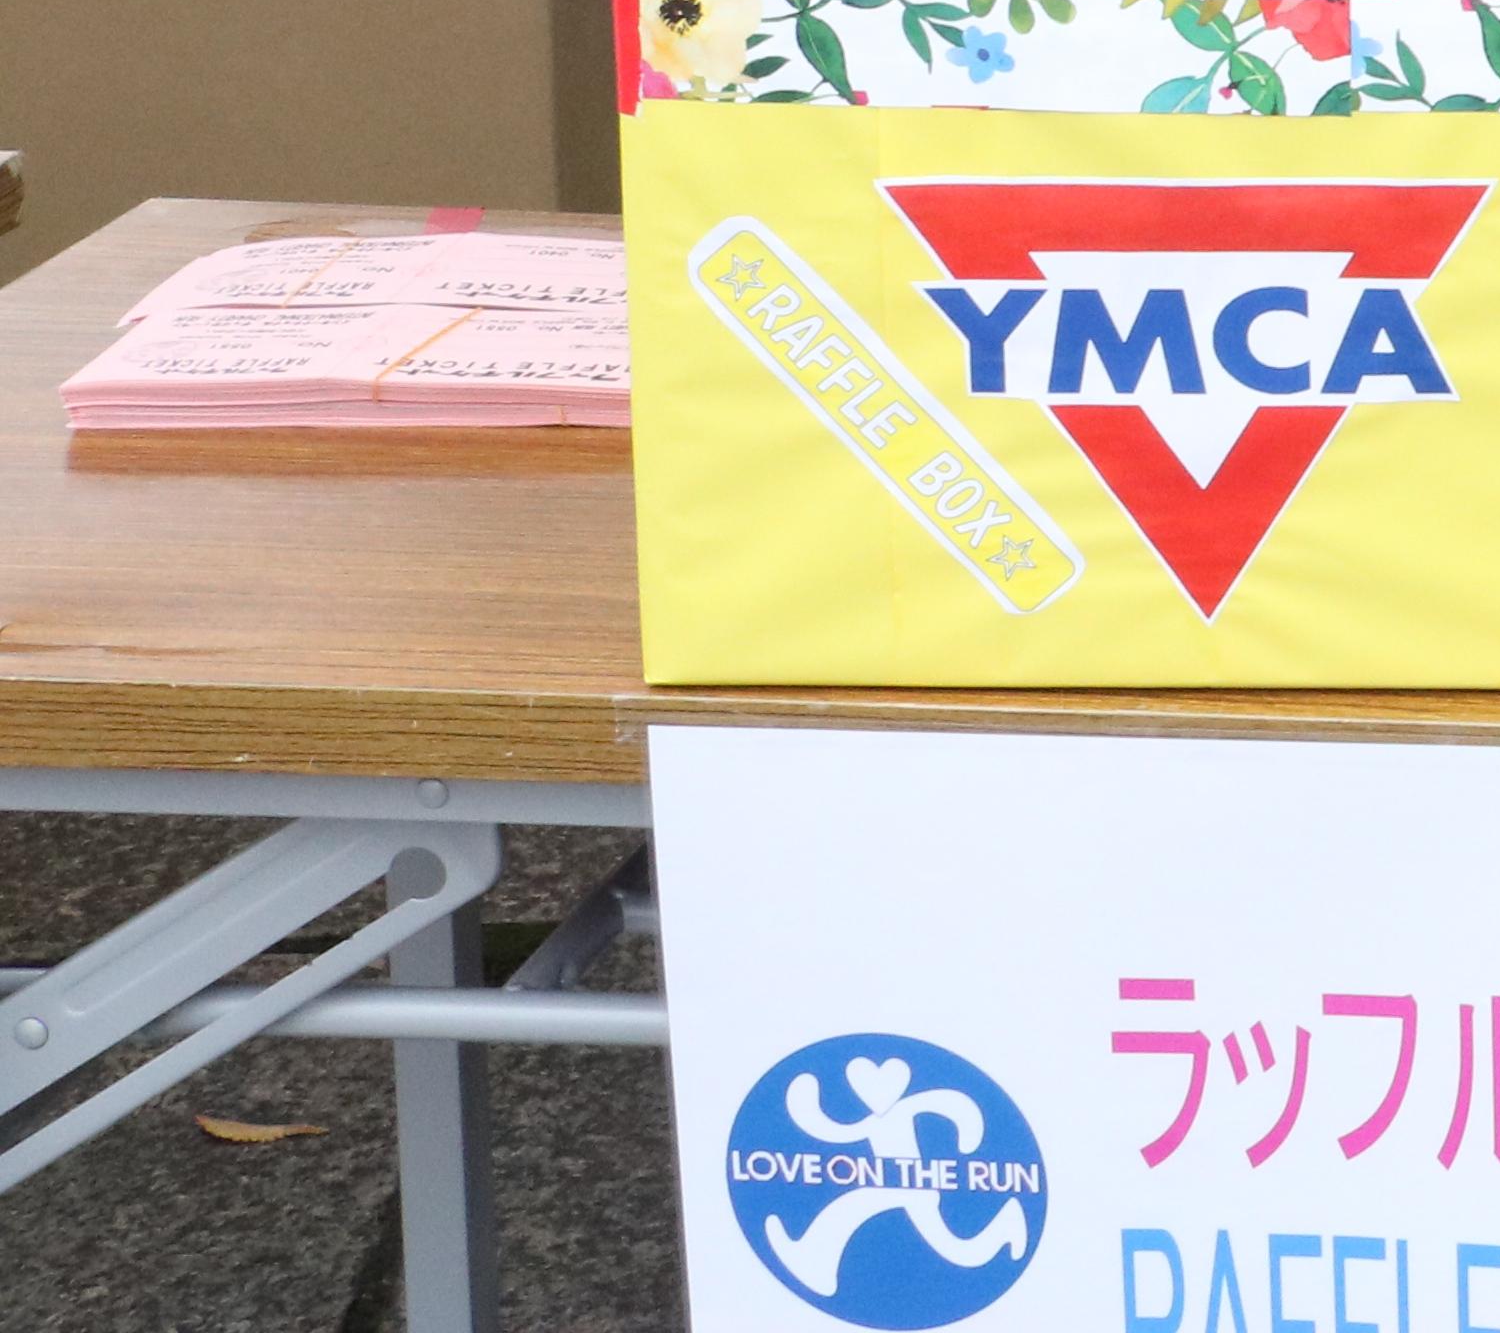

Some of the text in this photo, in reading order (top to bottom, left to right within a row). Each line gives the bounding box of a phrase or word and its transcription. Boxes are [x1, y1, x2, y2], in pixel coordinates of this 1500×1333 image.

[923, 287, 1457, 395] YMCA
[747, 283, 1014, 550] RAFFLE BOX
[731, 1149, 1041, 1194] LOVE ON THE RUN
